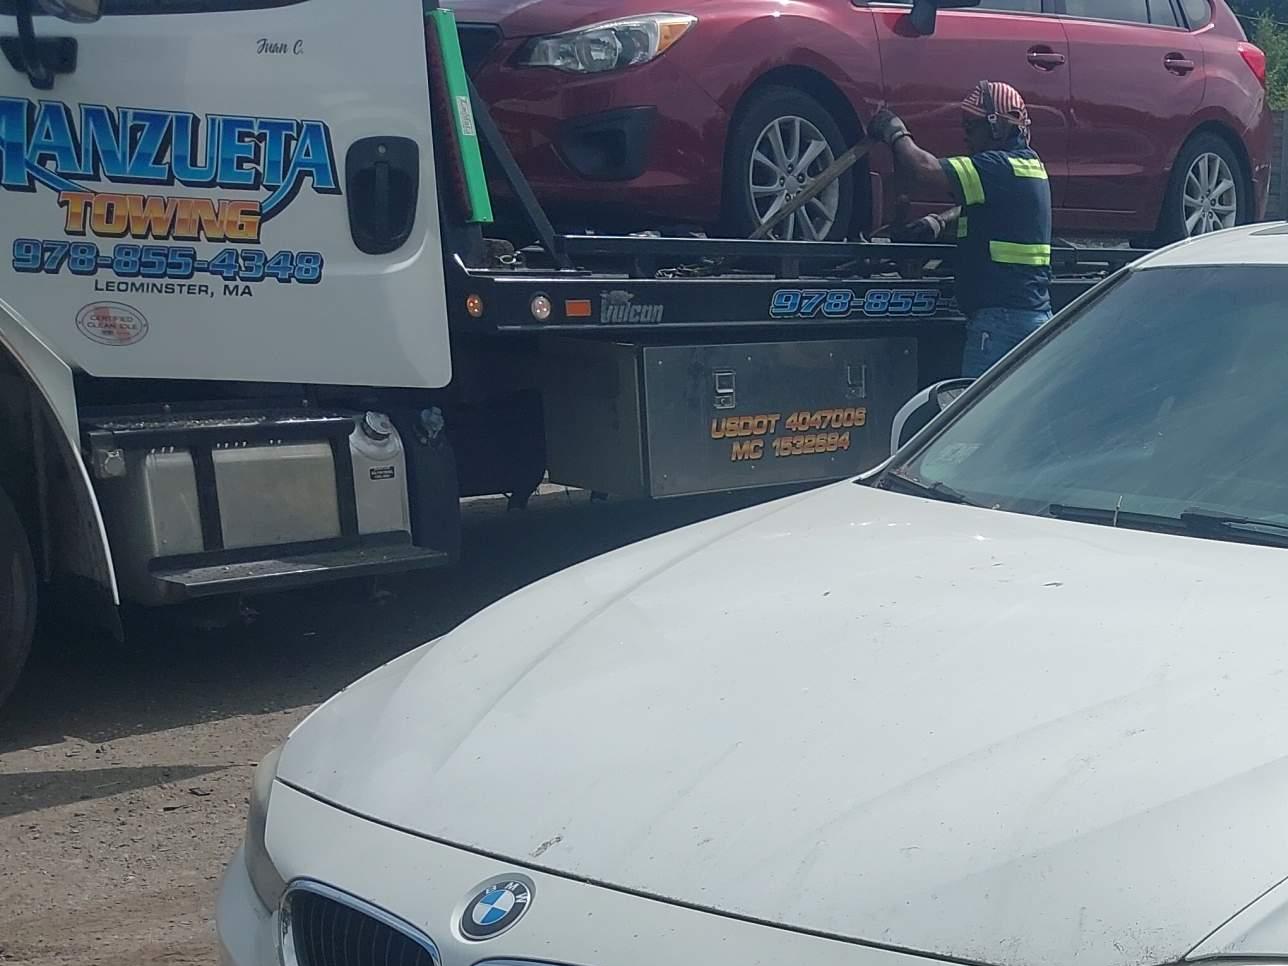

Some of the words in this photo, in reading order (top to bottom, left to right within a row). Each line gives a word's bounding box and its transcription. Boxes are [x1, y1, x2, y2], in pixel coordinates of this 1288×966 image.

[256, 38, 288, 55] Juan
[58, 191, 262, 244] TOWING
[12, 239, 324, 284] 978-855-4348
[94, 279, 215, 298] LEOMINSTER,
[223, 283, 253, 297] MA
[769, 289, 957, 318] 978-855-
[711, 413, 781, 439] USDOT
[731, 438, 763, 461] MC
